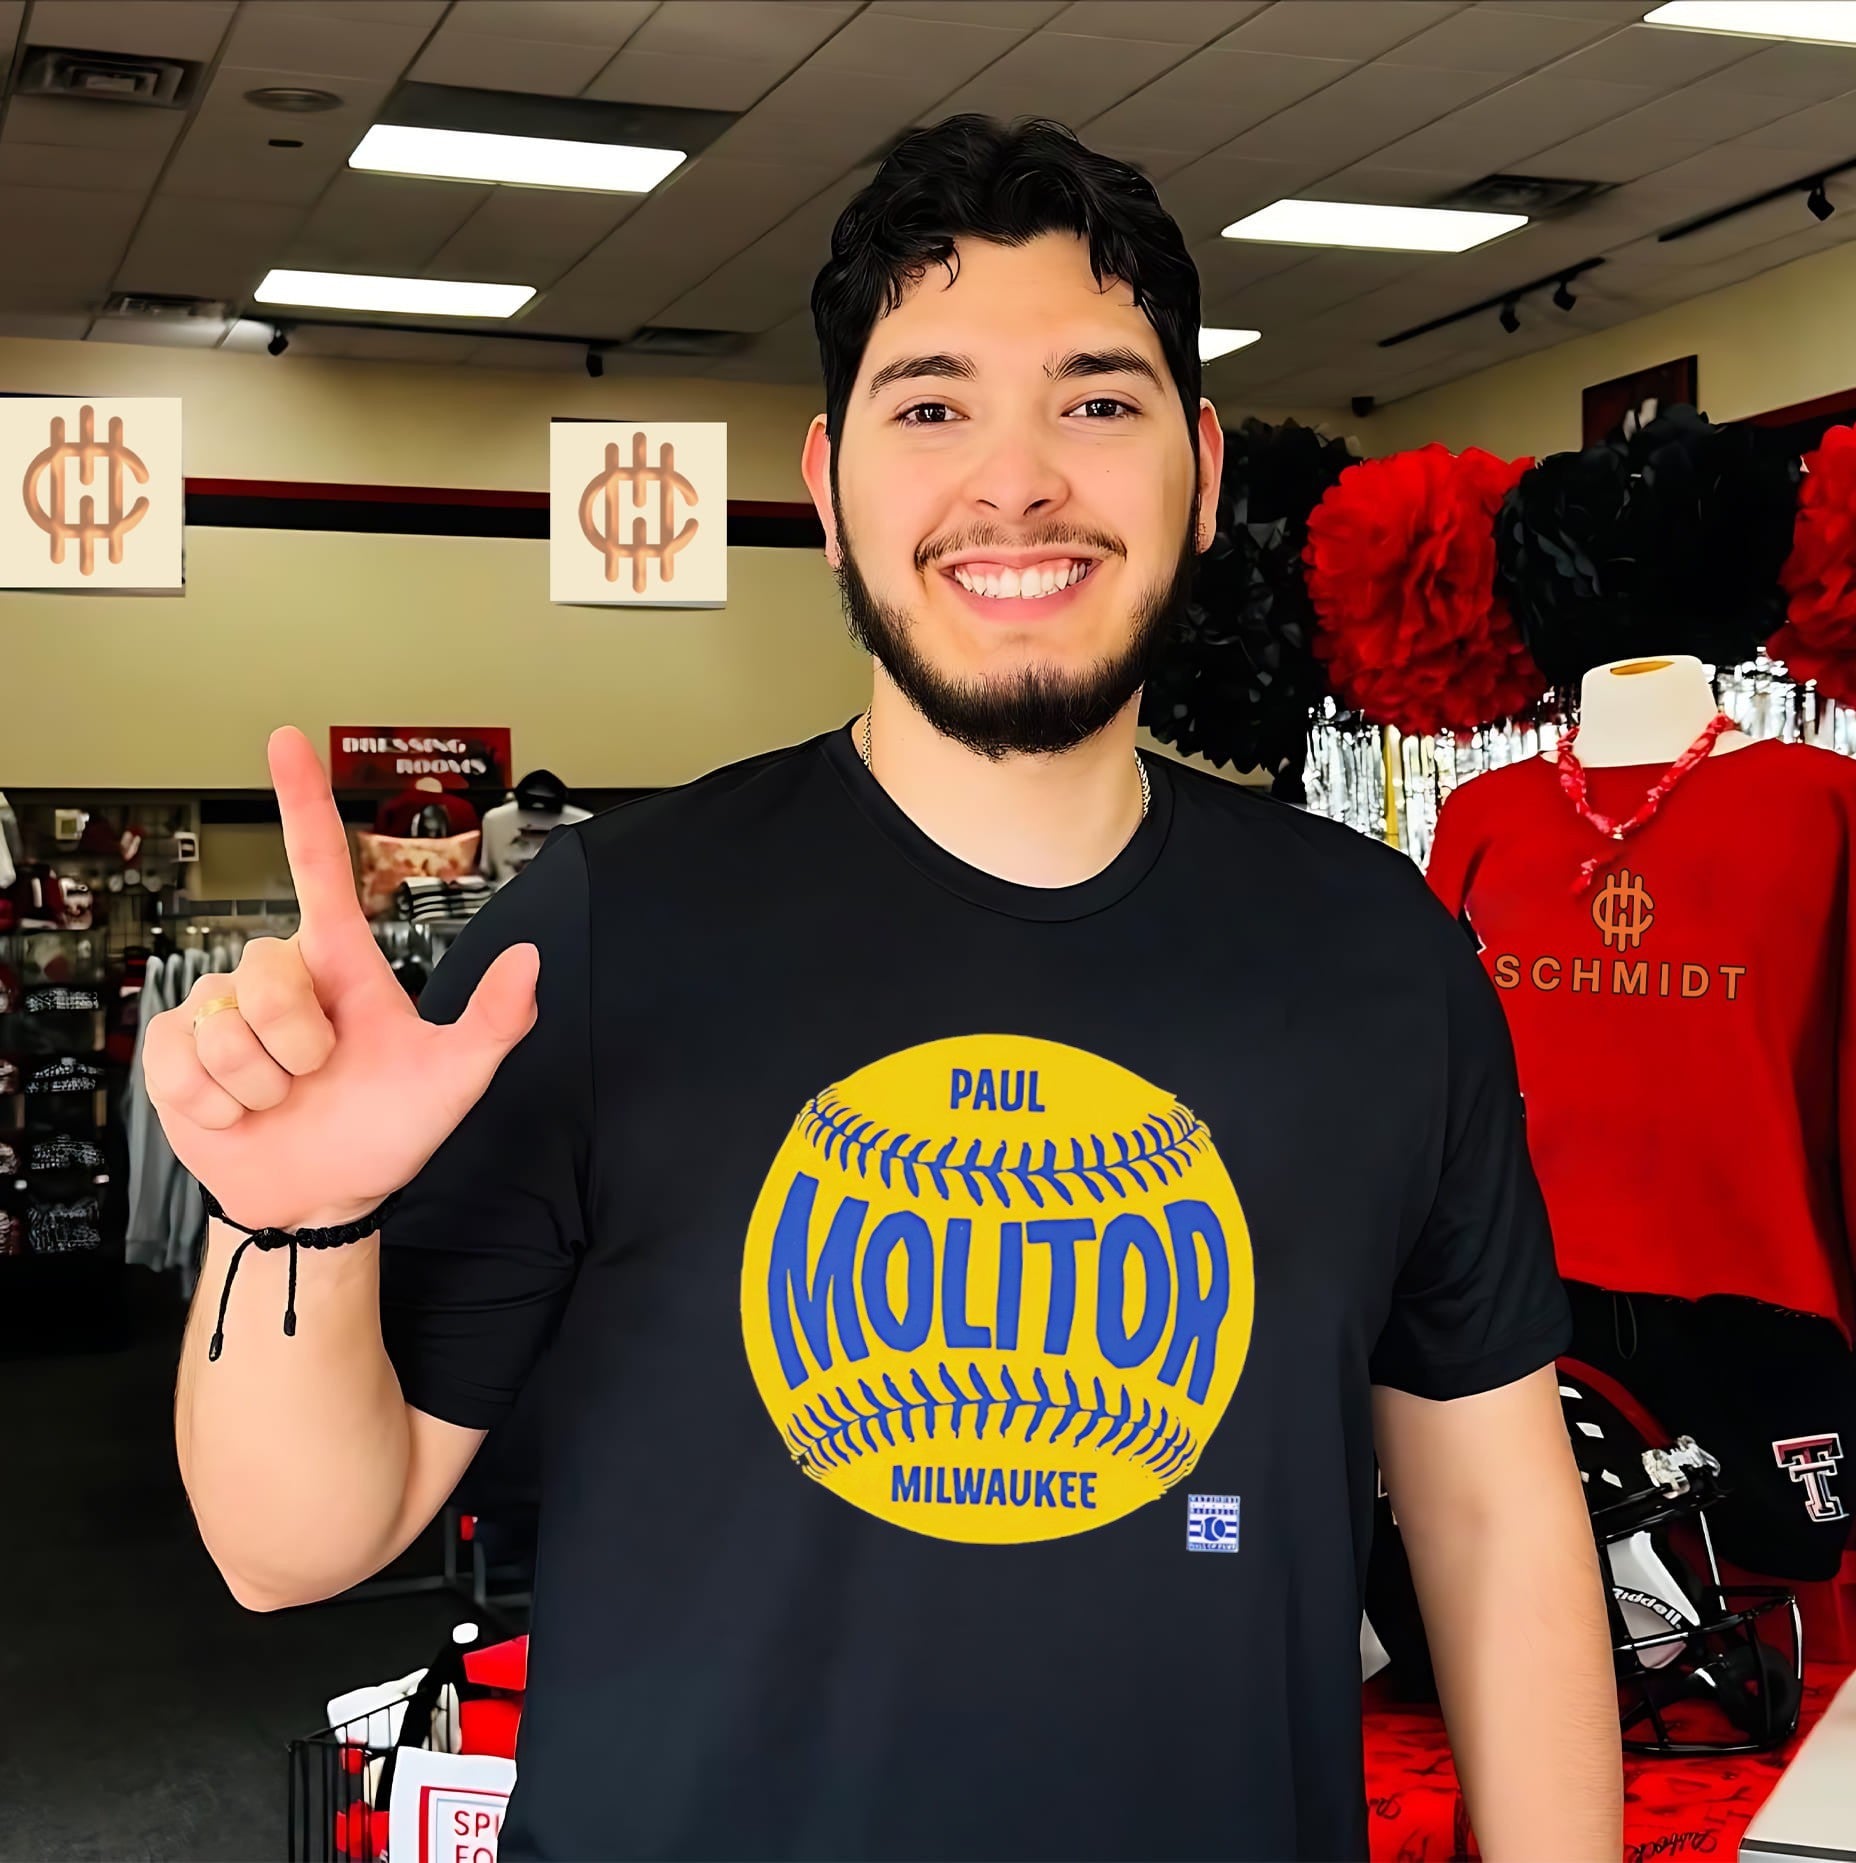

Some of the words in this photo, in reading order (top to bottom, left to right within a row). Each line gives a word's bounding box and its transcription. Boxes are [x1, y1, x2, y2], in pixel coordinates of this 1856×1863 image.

[342, 737, 467, 754] DRESSING
[396, 758, 487, 775] ROOMS
[1494, 954, 1746, 1000] SCHMIDT
[950, 1068, 1046, 1113] PAUL
[768, 1171, 1230, 1405] MOLITOR
[890, 1465, 1098, 1509] MILWAUKEE
